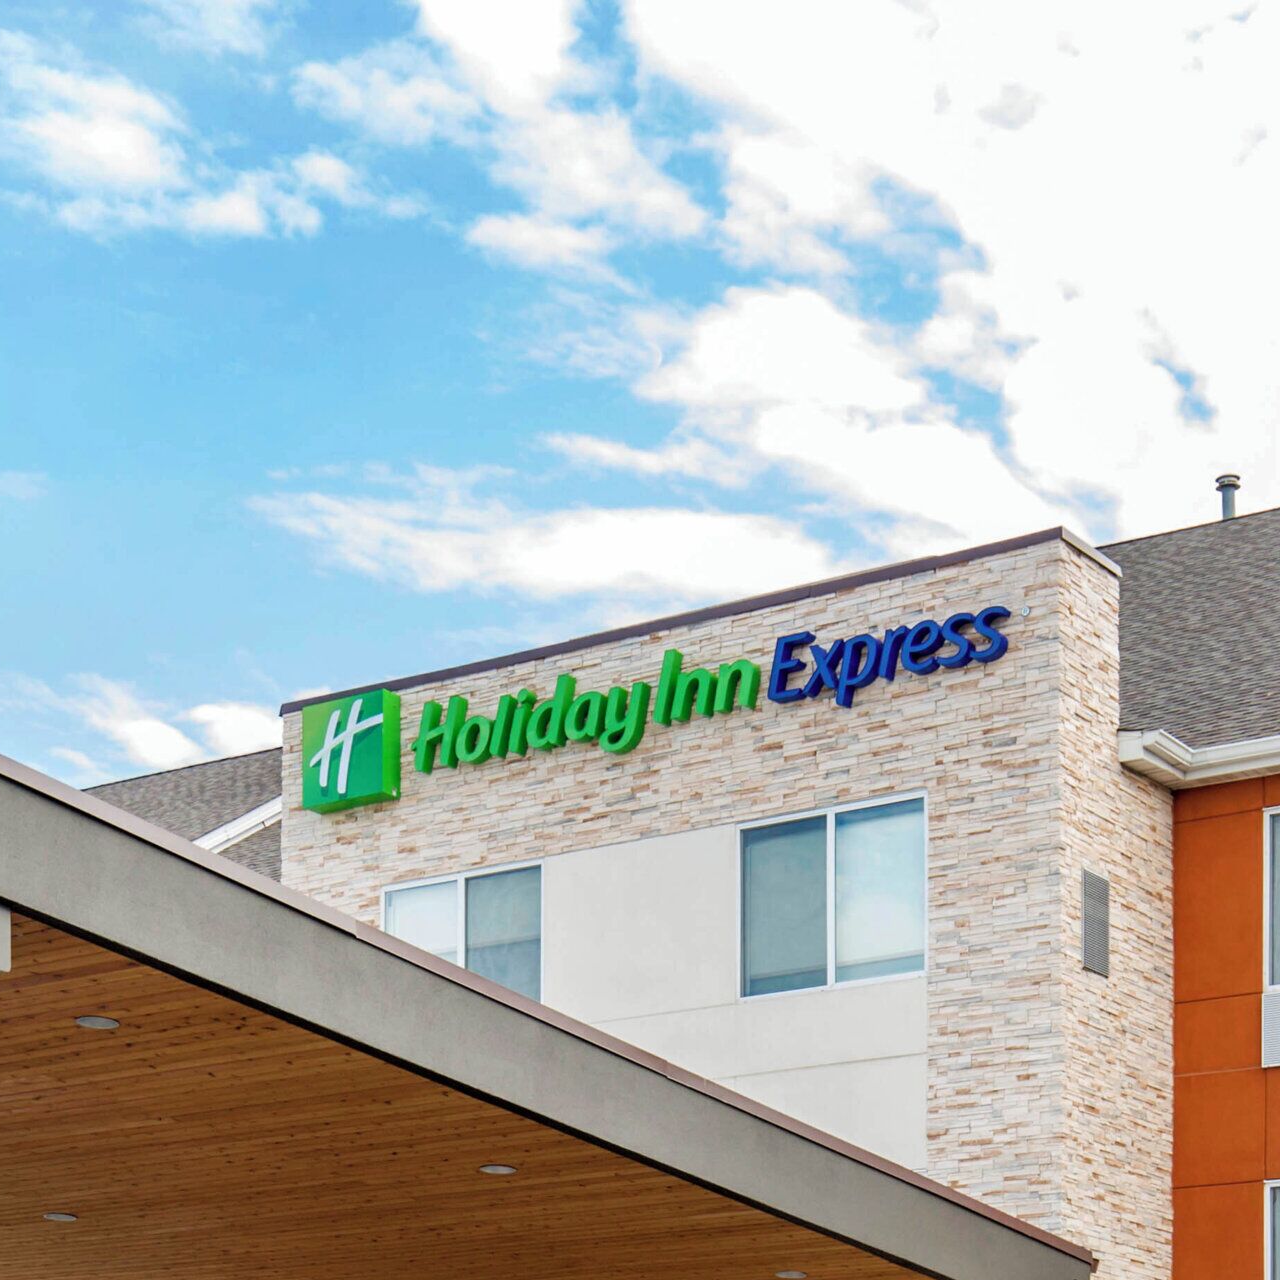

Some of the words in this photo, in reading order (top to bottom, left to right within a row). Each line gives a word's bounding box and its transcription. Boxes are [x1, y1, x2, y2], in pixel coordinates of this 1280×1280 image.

[309, 698, 384, 794] H
[411, 673, 651, 775] Holiday
[653, 648, 761, 726] Inn
[767, 605, 1011, 708] Express
